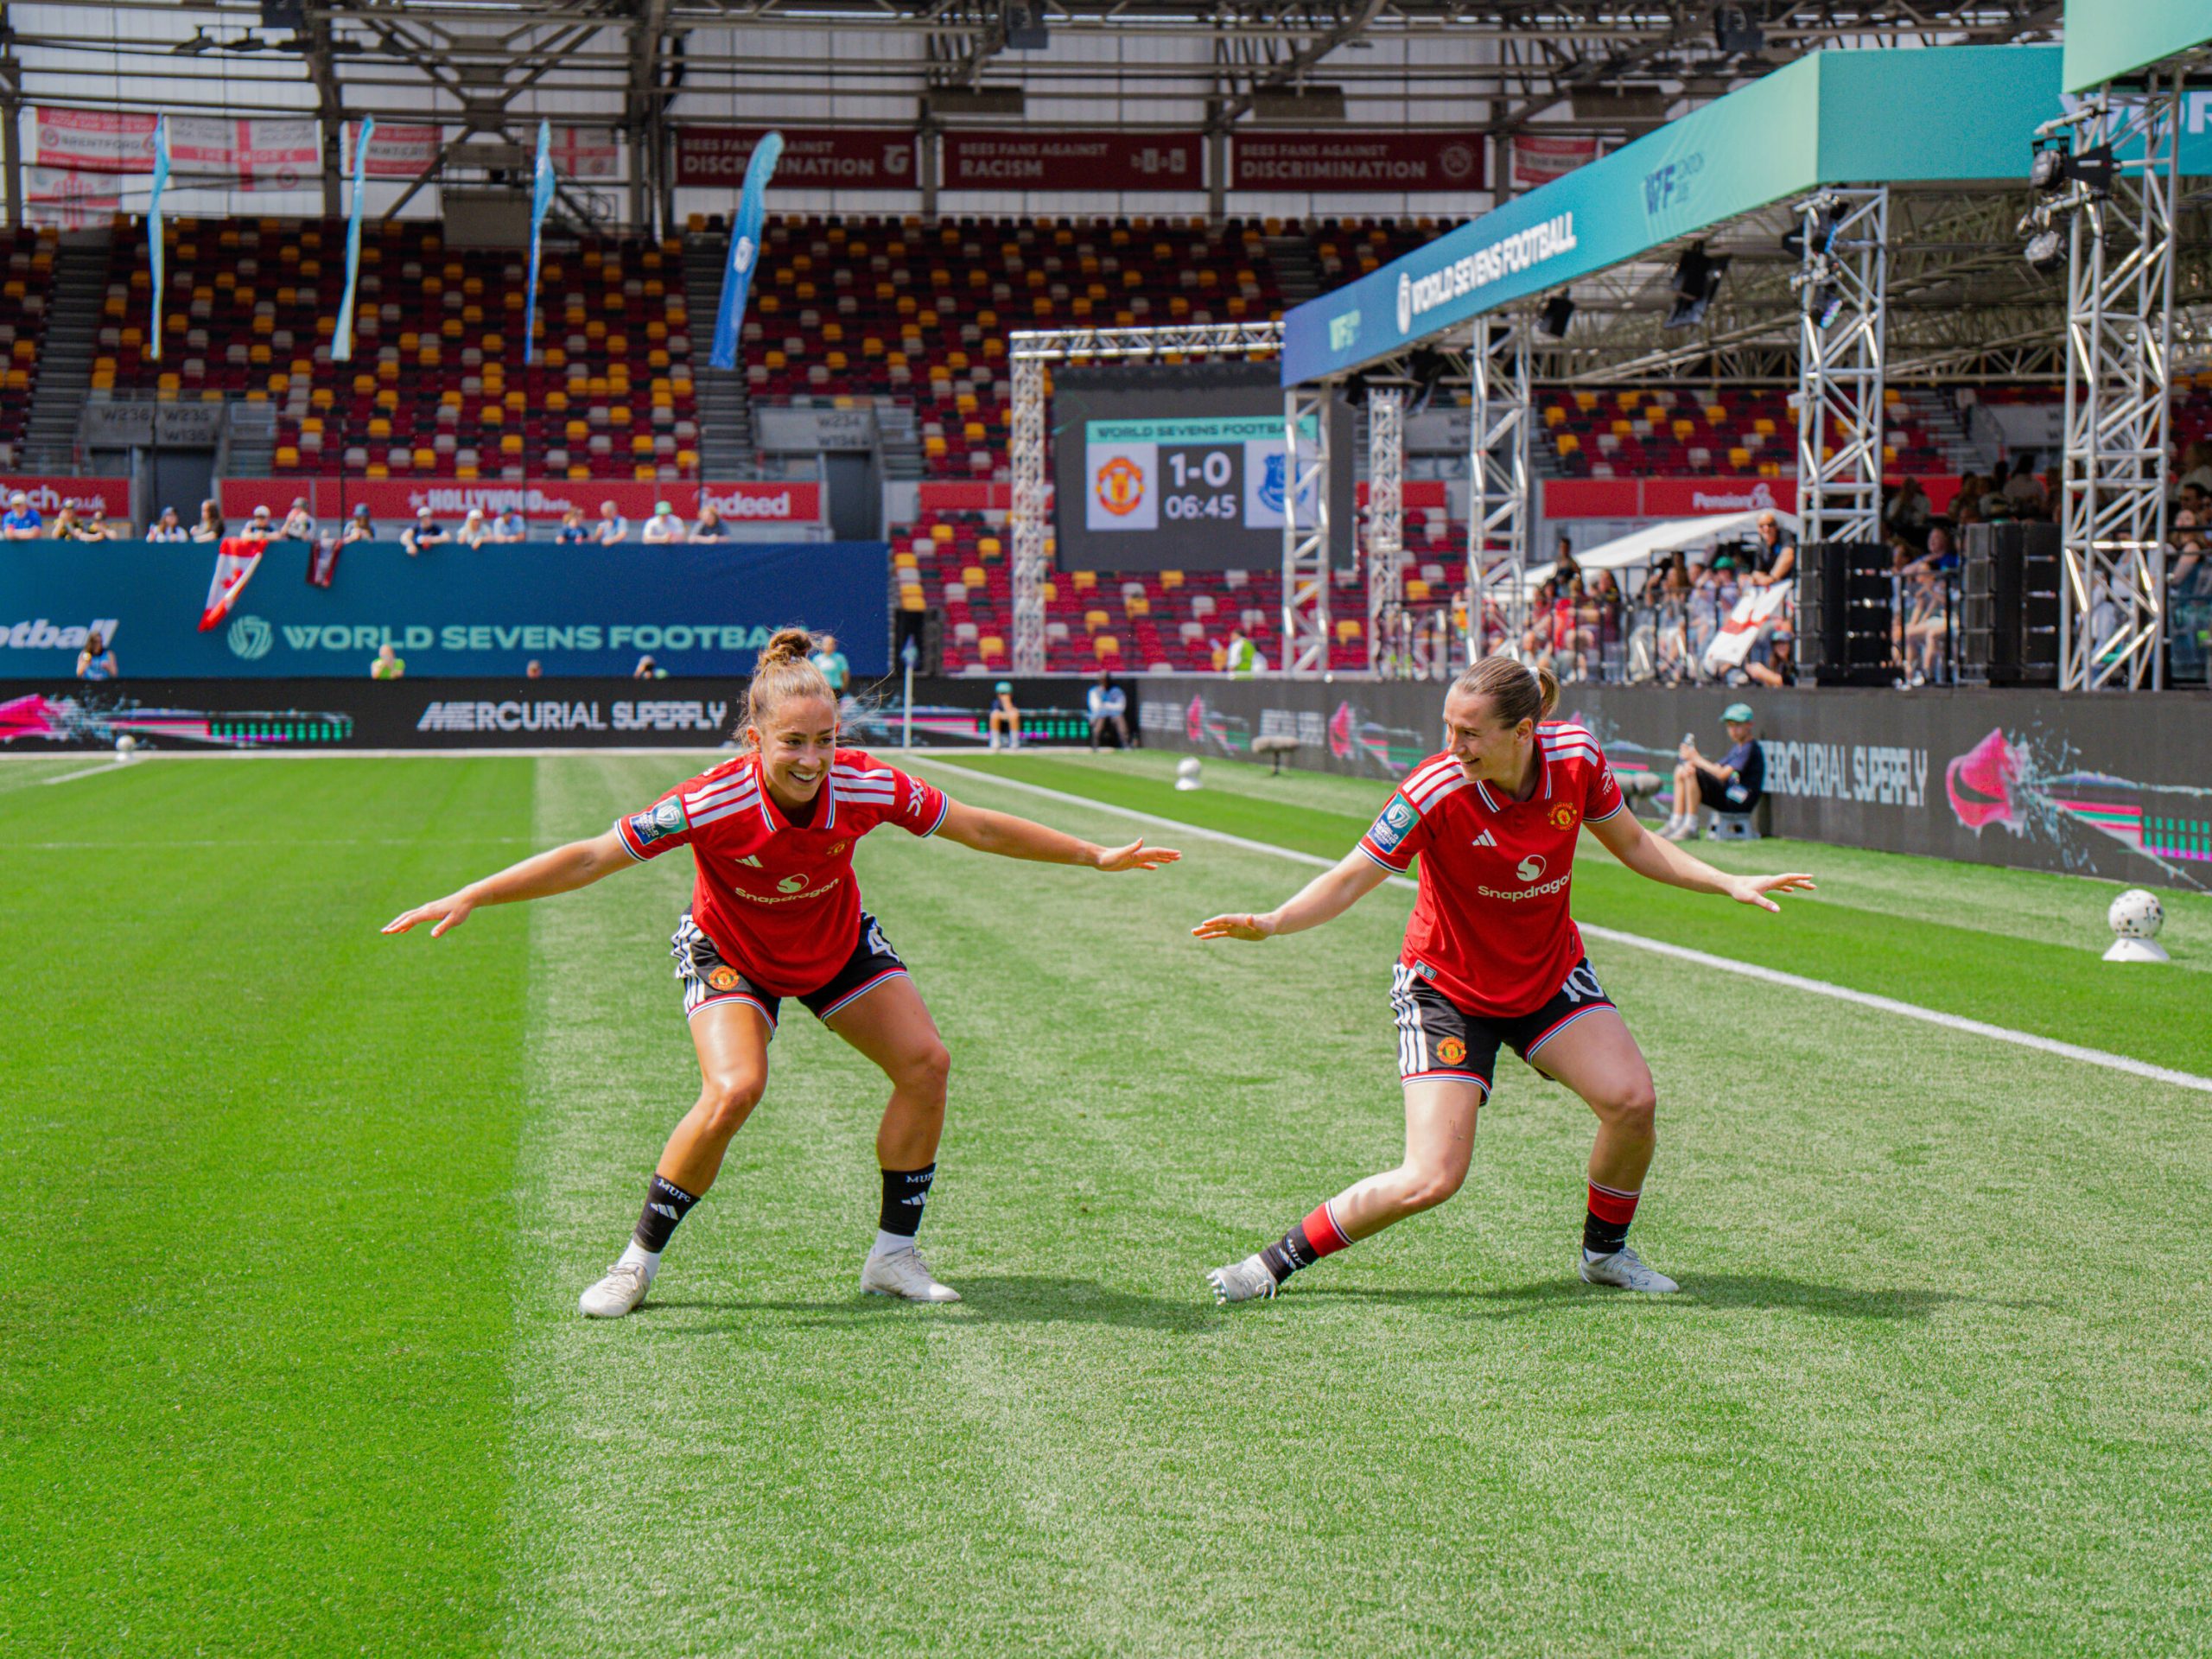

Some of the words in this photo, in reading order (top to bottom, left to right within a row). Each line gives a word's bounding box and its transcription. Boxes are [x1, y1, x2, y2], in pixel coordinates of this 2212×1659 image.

[683, 139, 719, 151] BEES
[722, 139, 756, 152] FAN
[959, 143, 995, 155] BEES
[999, 143, 1036, 156] FANS
[1040, 143, 1108, 156] AGAINST
[1241, 143, 1275, 156] BEES
[1281, 144, 1318, 156] FANS
[1322, 144, 1387, 157] AGAINST
[959, 159, 1043, 177] RACISM
[1241, 161, 1427, 178] DISCRIMINATION
[1412, 264, 1453, 315] WORLD
[1453, 242, 1503, 296] SEVENS
[1503, 211, 1578, 275] FOOTBALL
[1096, 425, 1154, 439] WORLD
[1158, 423, 1217, 437] SEVENS
[1168, 450, 1232, 489] 1-0
[1165, 494, 1237, 520] 06:45
[283, 625, 434, 650] WORLD
[441, 625, 602, 650] SEVENS
[609, 625, 809, 650] FOOTBA
[416, 702, 607, 731] MERCURIAL
[612, 702, 728, 731] SUPERFLY
[1853, 745, 1929, 808] SUPERFLY
[735, 877, 840, 905] Snapdragon
[1561, 966, 1605, 1003] 10
[657, 1178, 691, 1203] MUFC
